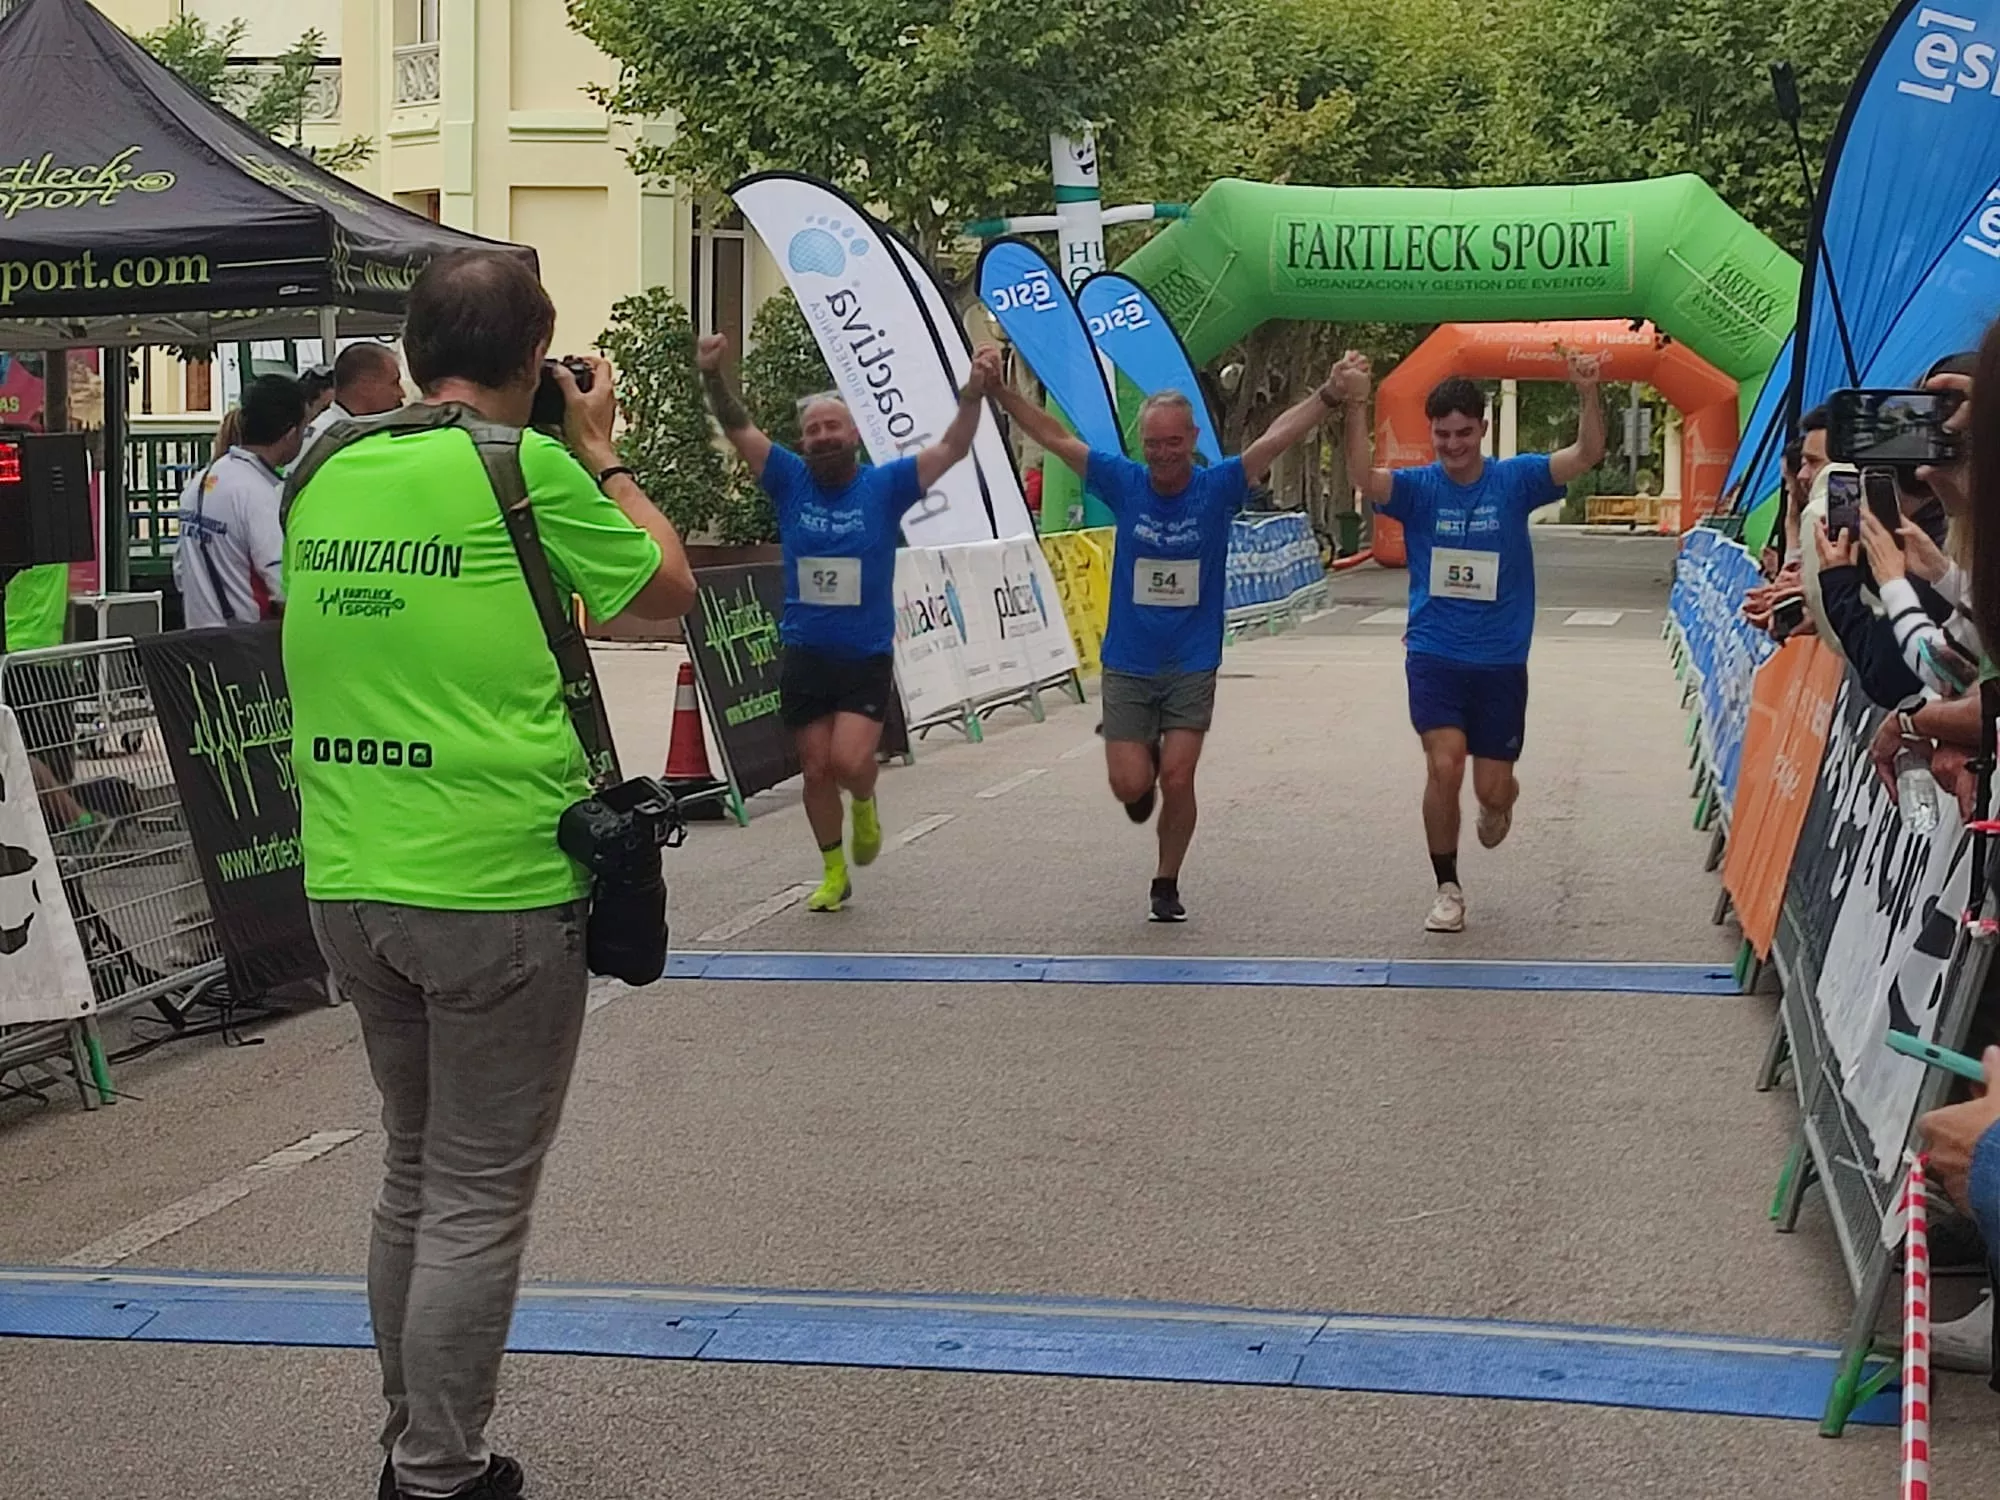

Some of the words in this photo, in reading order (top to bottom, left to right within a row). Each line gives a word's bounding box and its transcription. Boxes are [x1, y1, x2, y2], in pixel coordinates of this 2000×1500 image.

[1288, 222, 1480, 272] FARTLECK
[1492, 220, 1616, 271] SPORT
[1506, 278, 1527, 290] DE
[1531, 275, 1607, 290] EVENTOS
[1595, 331, 1651, 345] Huesca
[294, 534, 463, 579] ORGANIZACIÓN
[813, 570, 838, 586] 52
[1151, 572, 1176, 588] 54
[1448, 565, 1474, 582] 53
[225, 671, 294, 742] Fartlec
